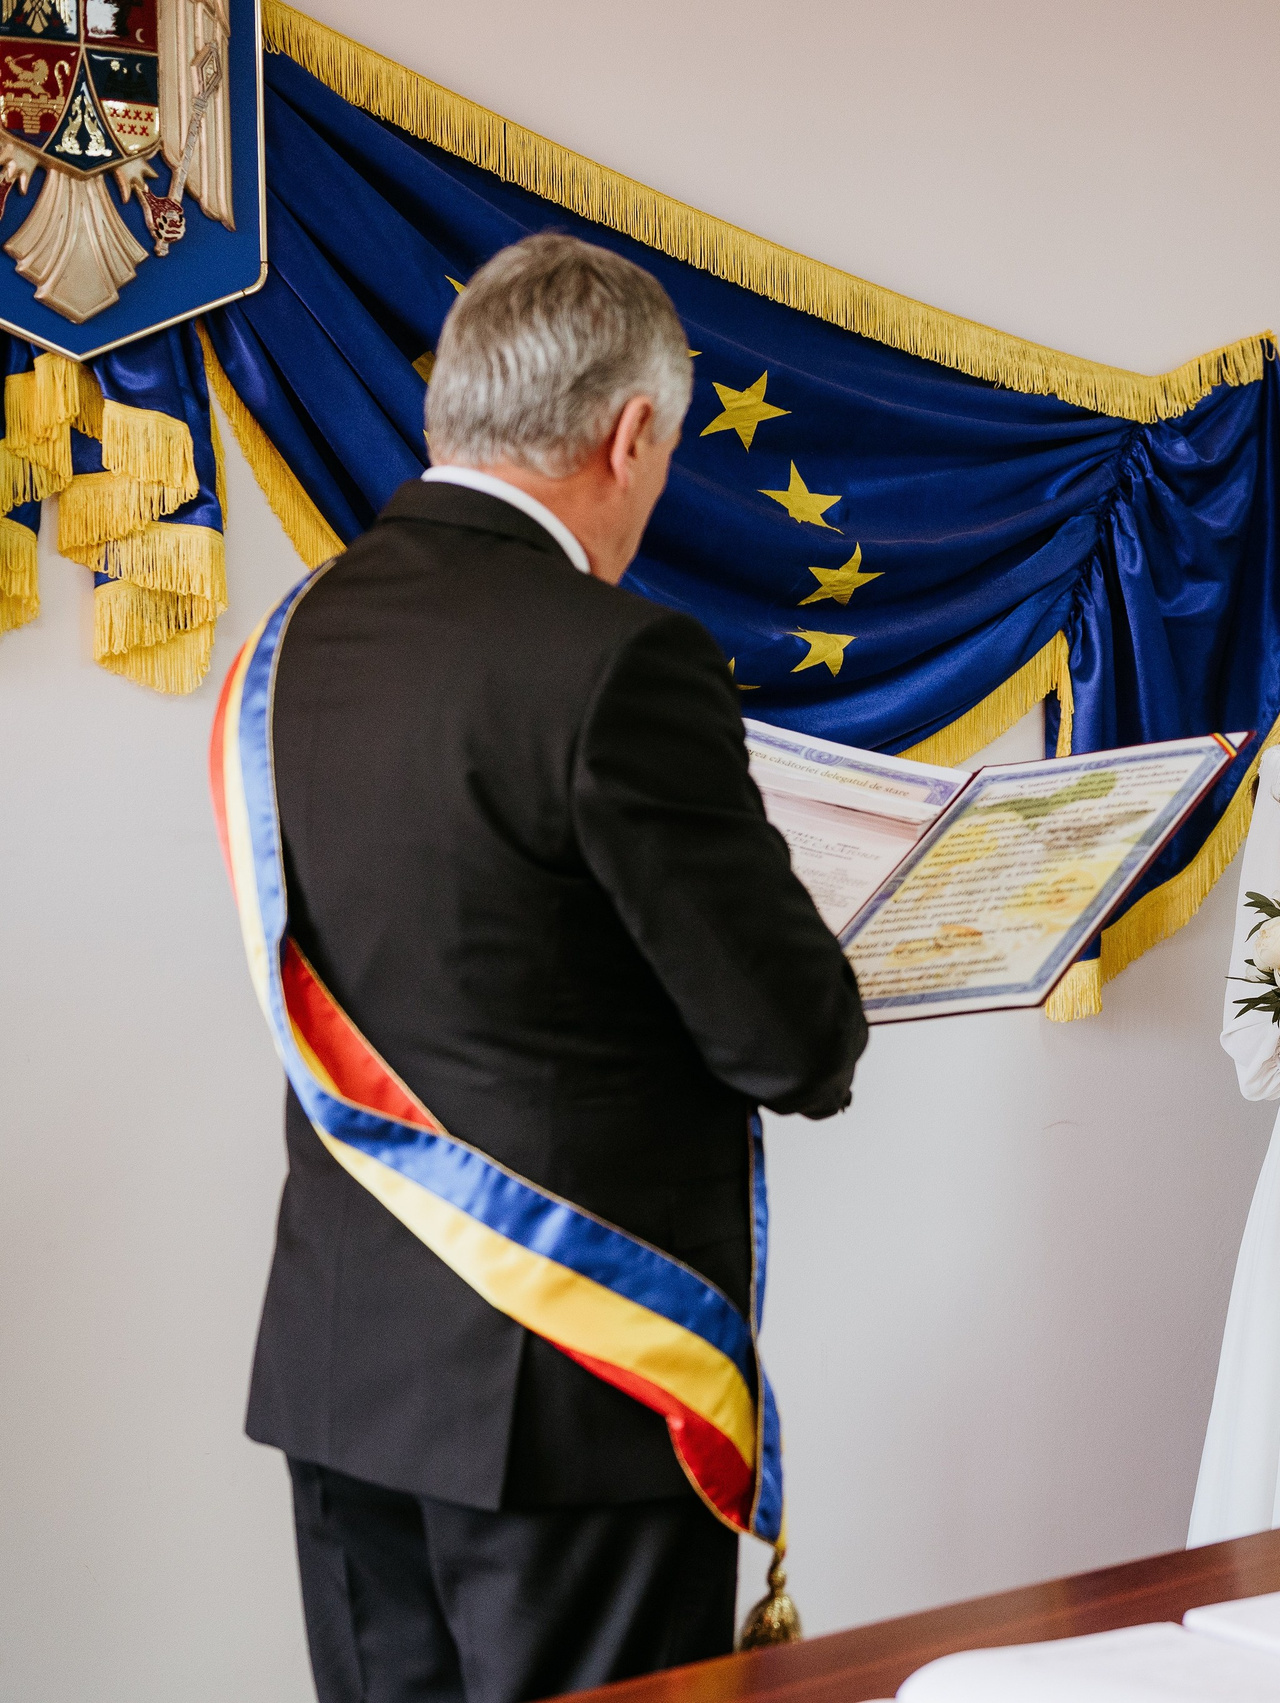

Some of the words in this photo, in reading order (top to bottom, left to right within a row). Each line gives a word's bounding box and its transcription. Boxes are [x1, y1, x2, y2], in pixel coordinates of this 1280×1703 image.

[820, 770, 869, 787] delegatul
[869, 781, 883, 791] de
[884, 787, 910, 797] stare
